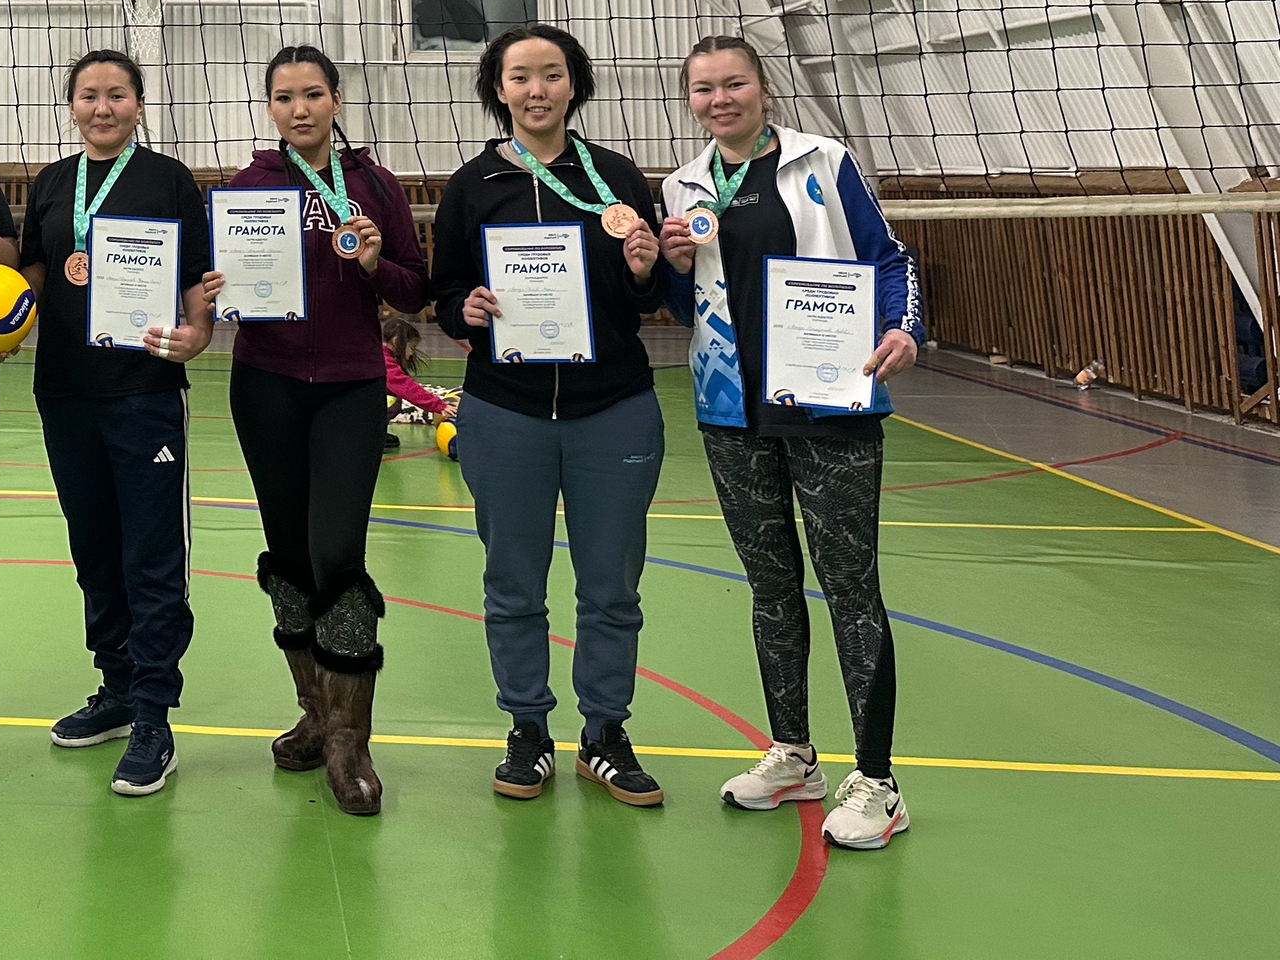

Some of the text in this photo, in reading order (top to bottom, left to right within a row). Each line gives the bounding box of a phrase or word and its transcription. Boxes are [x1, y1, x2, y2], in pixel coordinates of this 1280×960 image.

[228, 225, 286, 236] ГРАМОТА
[106, 253, 162, 267] ГРАМОТА
[505, 263, 567, 274] ГРАМОТА
[785, 299, 856, 315] ГРАМОТА
